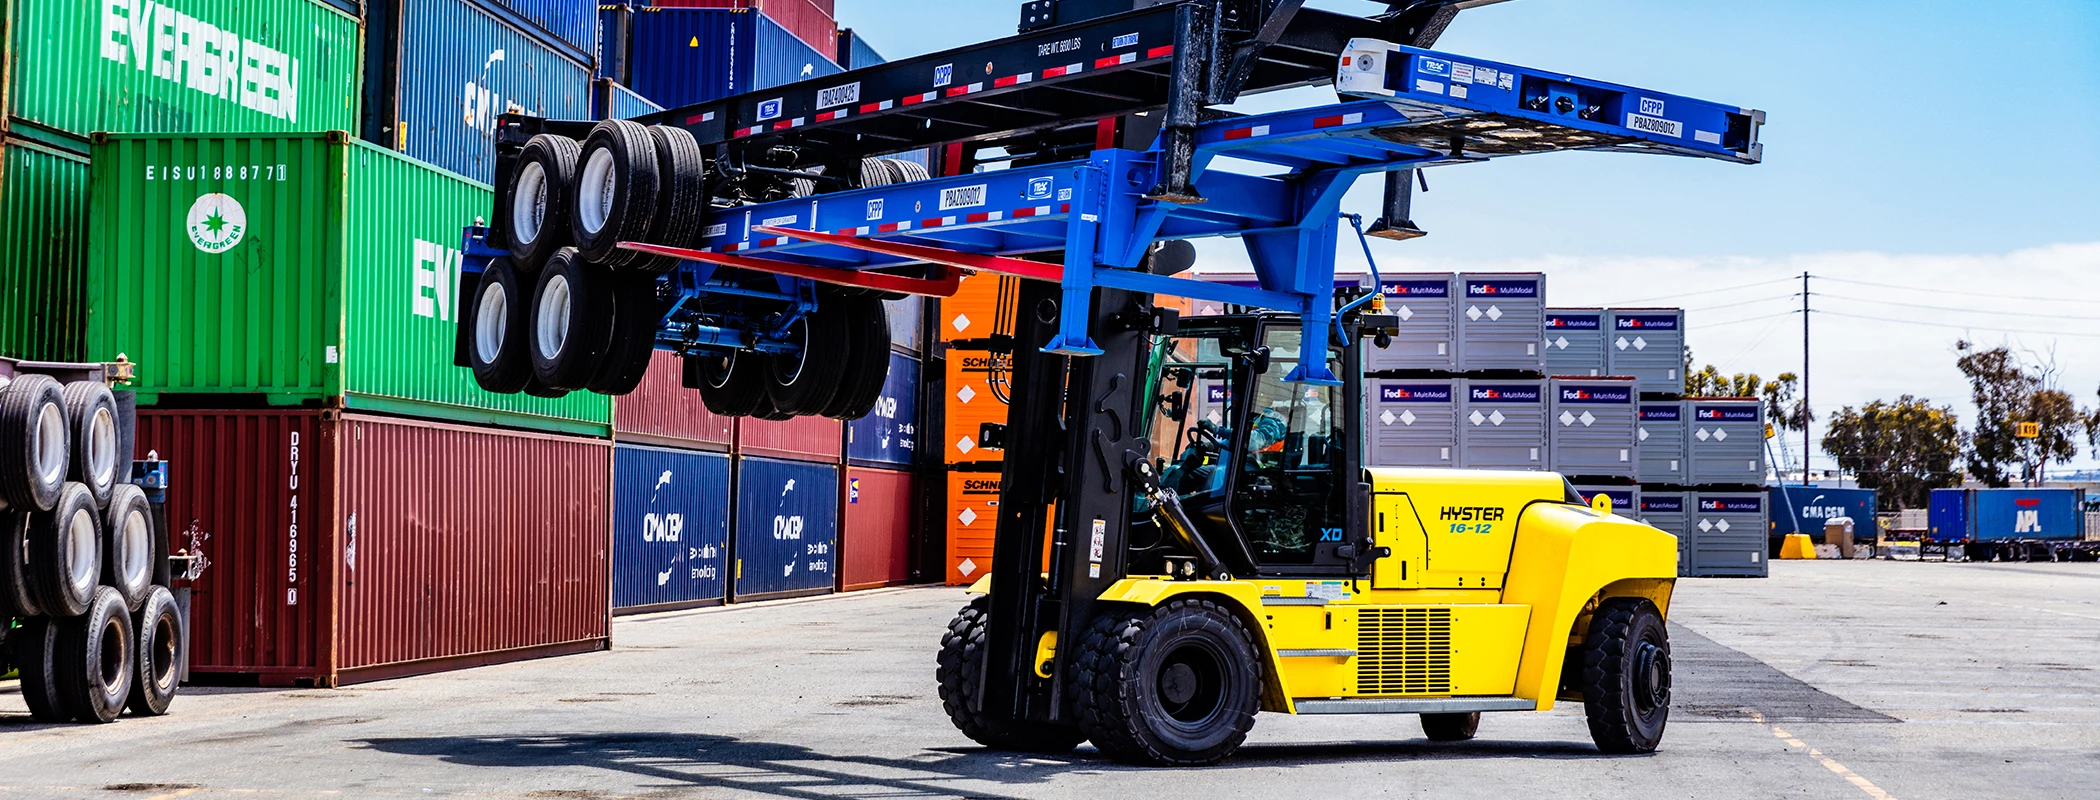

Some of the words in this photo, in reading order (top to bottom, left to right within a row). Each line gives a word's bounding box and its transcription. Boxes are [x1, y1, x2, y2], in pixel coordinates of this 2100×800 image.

[101, 0, 298, 123] EVERGREEN
[1426, 61, 1444, 70] TRAC
[935, 66, 951, 85] CCPP
[822, 85, 854, 107] FBAZ400425
[1642, 100, 1662, 114] CFPP
[1634, 116, 1675, 134] PBAZ809012
[1034, 182, 1048, 191] TRAC
[945, 187, 981, 207] PBAZ809012
[868, 201, 882, 218] CFPP
[191, 225, 241, 250] EVERGREEN
[1381, 285, 1408, 294] FedEx
[1470, 285, 1496, 294] FedEx
[1546, 318, 1564, 326] edEx
[1619, 319, 1642, 327] FedEx
[1384, 389, 1411, 398] FedEx
[1473, 389, 1499, 399] FedEx
[1563, 390, 1589, 399] FedEx
[1699, 410, 1722, 418] FedEx
[290, 432, 299, 490] DRYU
[1702, 501, 1725, 509] FedEx
[1440, 506, 1504, 521] HYSTER
[1803, 506, 1823, 518] CMA
[1825, 507, 1845, 518] CGM
[2015, 510, 2041, 532] APL
[1450, 523, 1492, 533] 16-12
[289, 495, 298, 582] 416965
[1320, 528, 1343, 541] XD
